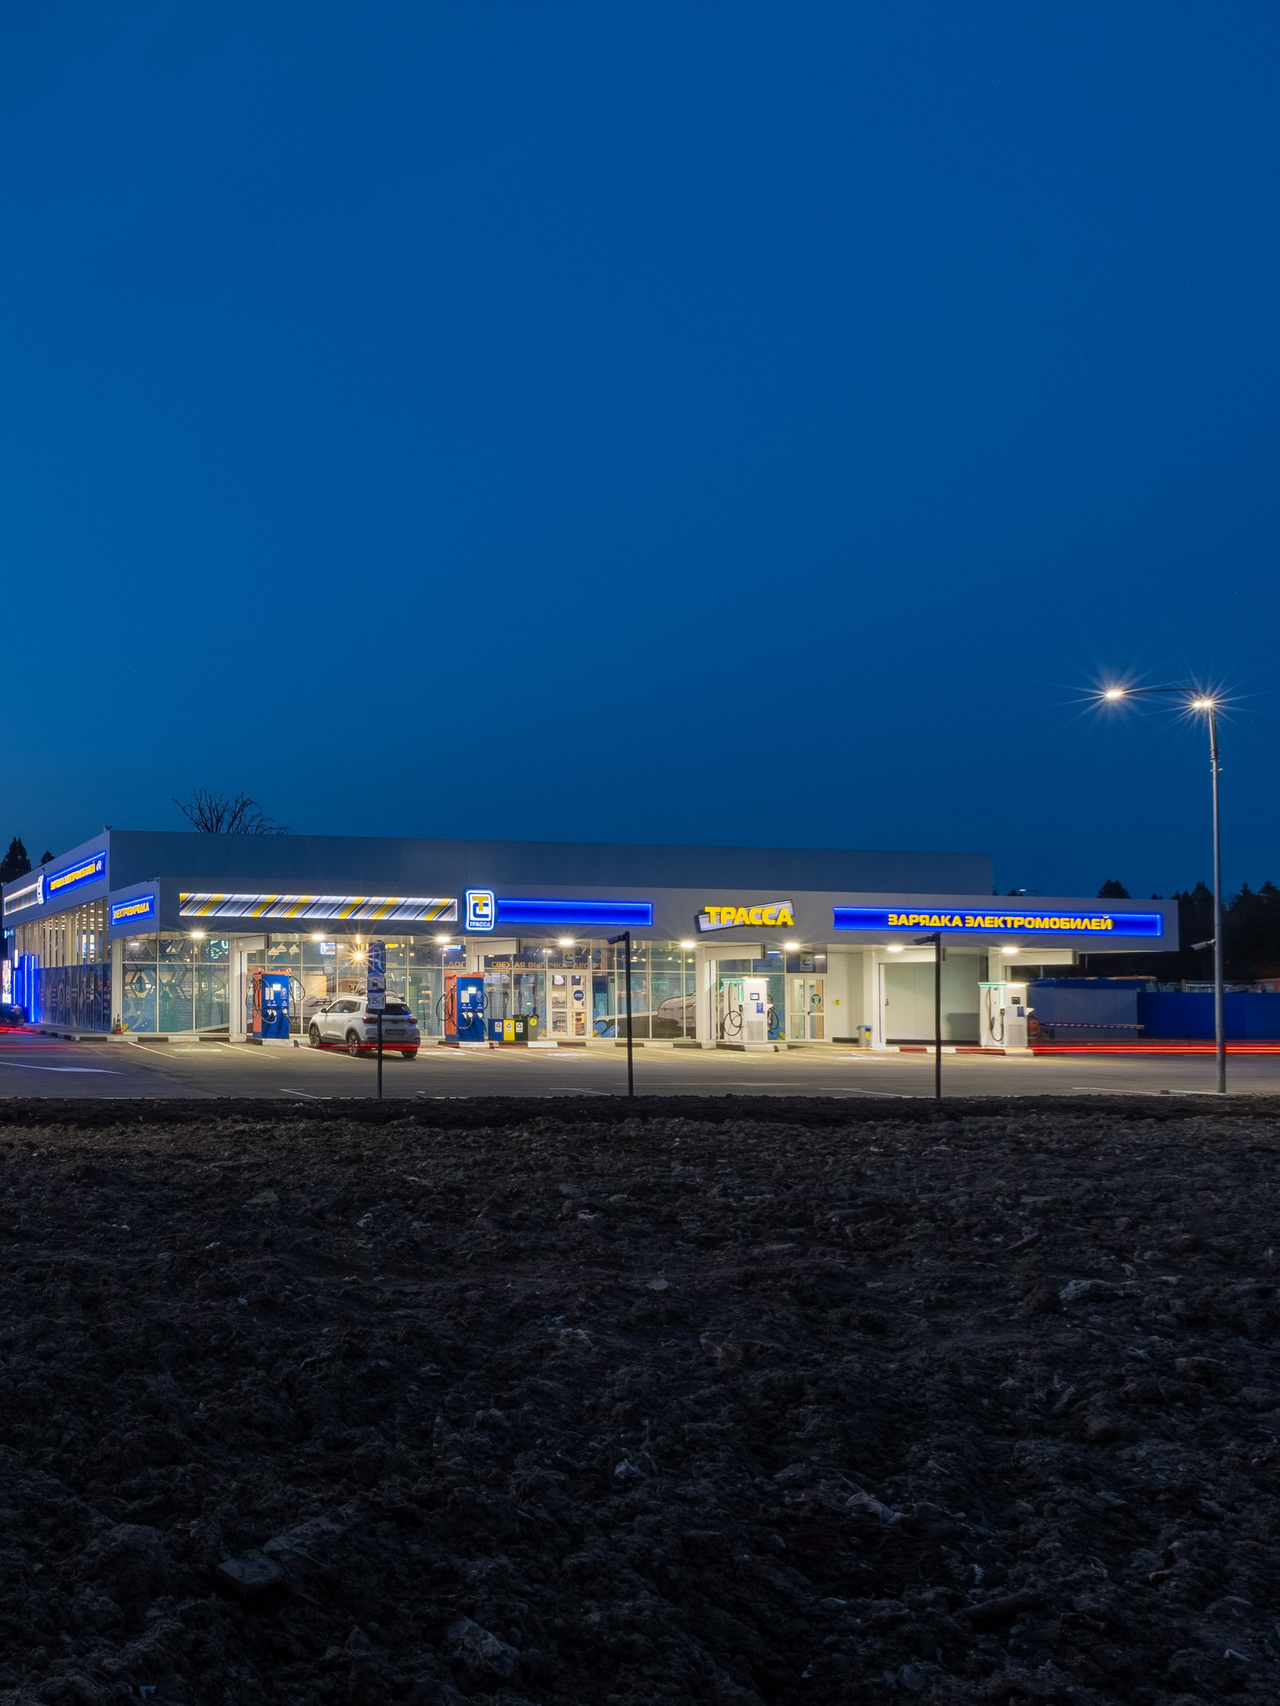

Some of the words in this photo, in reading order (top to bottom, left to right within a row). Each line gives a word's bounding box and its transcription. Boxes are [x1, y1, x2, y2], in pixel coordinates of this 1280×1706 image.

[704, 905, 795, 926] ТРАССА
[888, 913, 963, 927] ЗАРЯДКА
[965, 915, 1114, 931] ЭЛЕКТРОМОБИЛЕЙ
